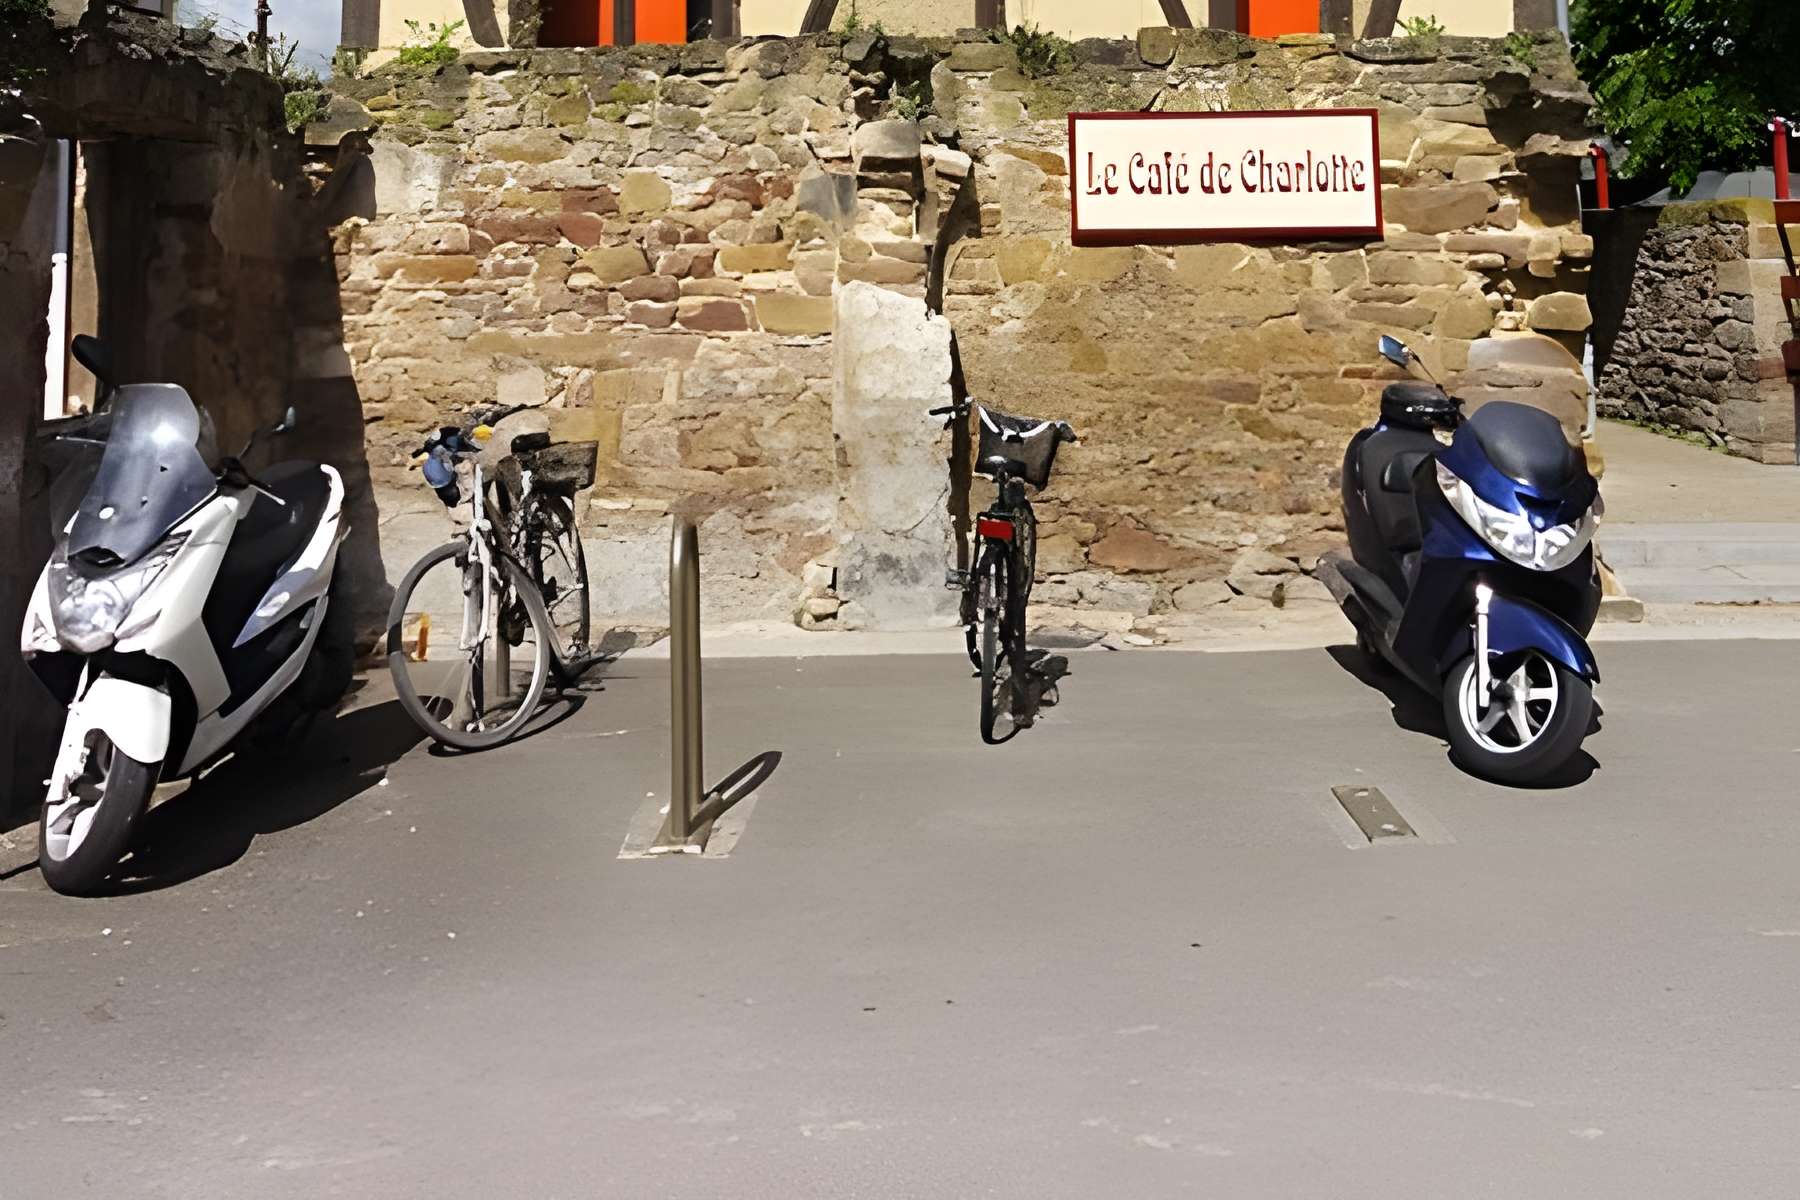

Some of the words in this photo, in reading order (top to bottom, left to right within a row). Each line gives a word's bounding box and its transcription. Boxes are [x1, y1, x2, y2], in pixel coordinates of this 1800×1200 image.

[1086, 152, 1118, 195] Le
[1129, 152, 1189, 195] Café
[1200, 152, 1232, 194] de
[1241, 150, 1365, 193] Charlotte
